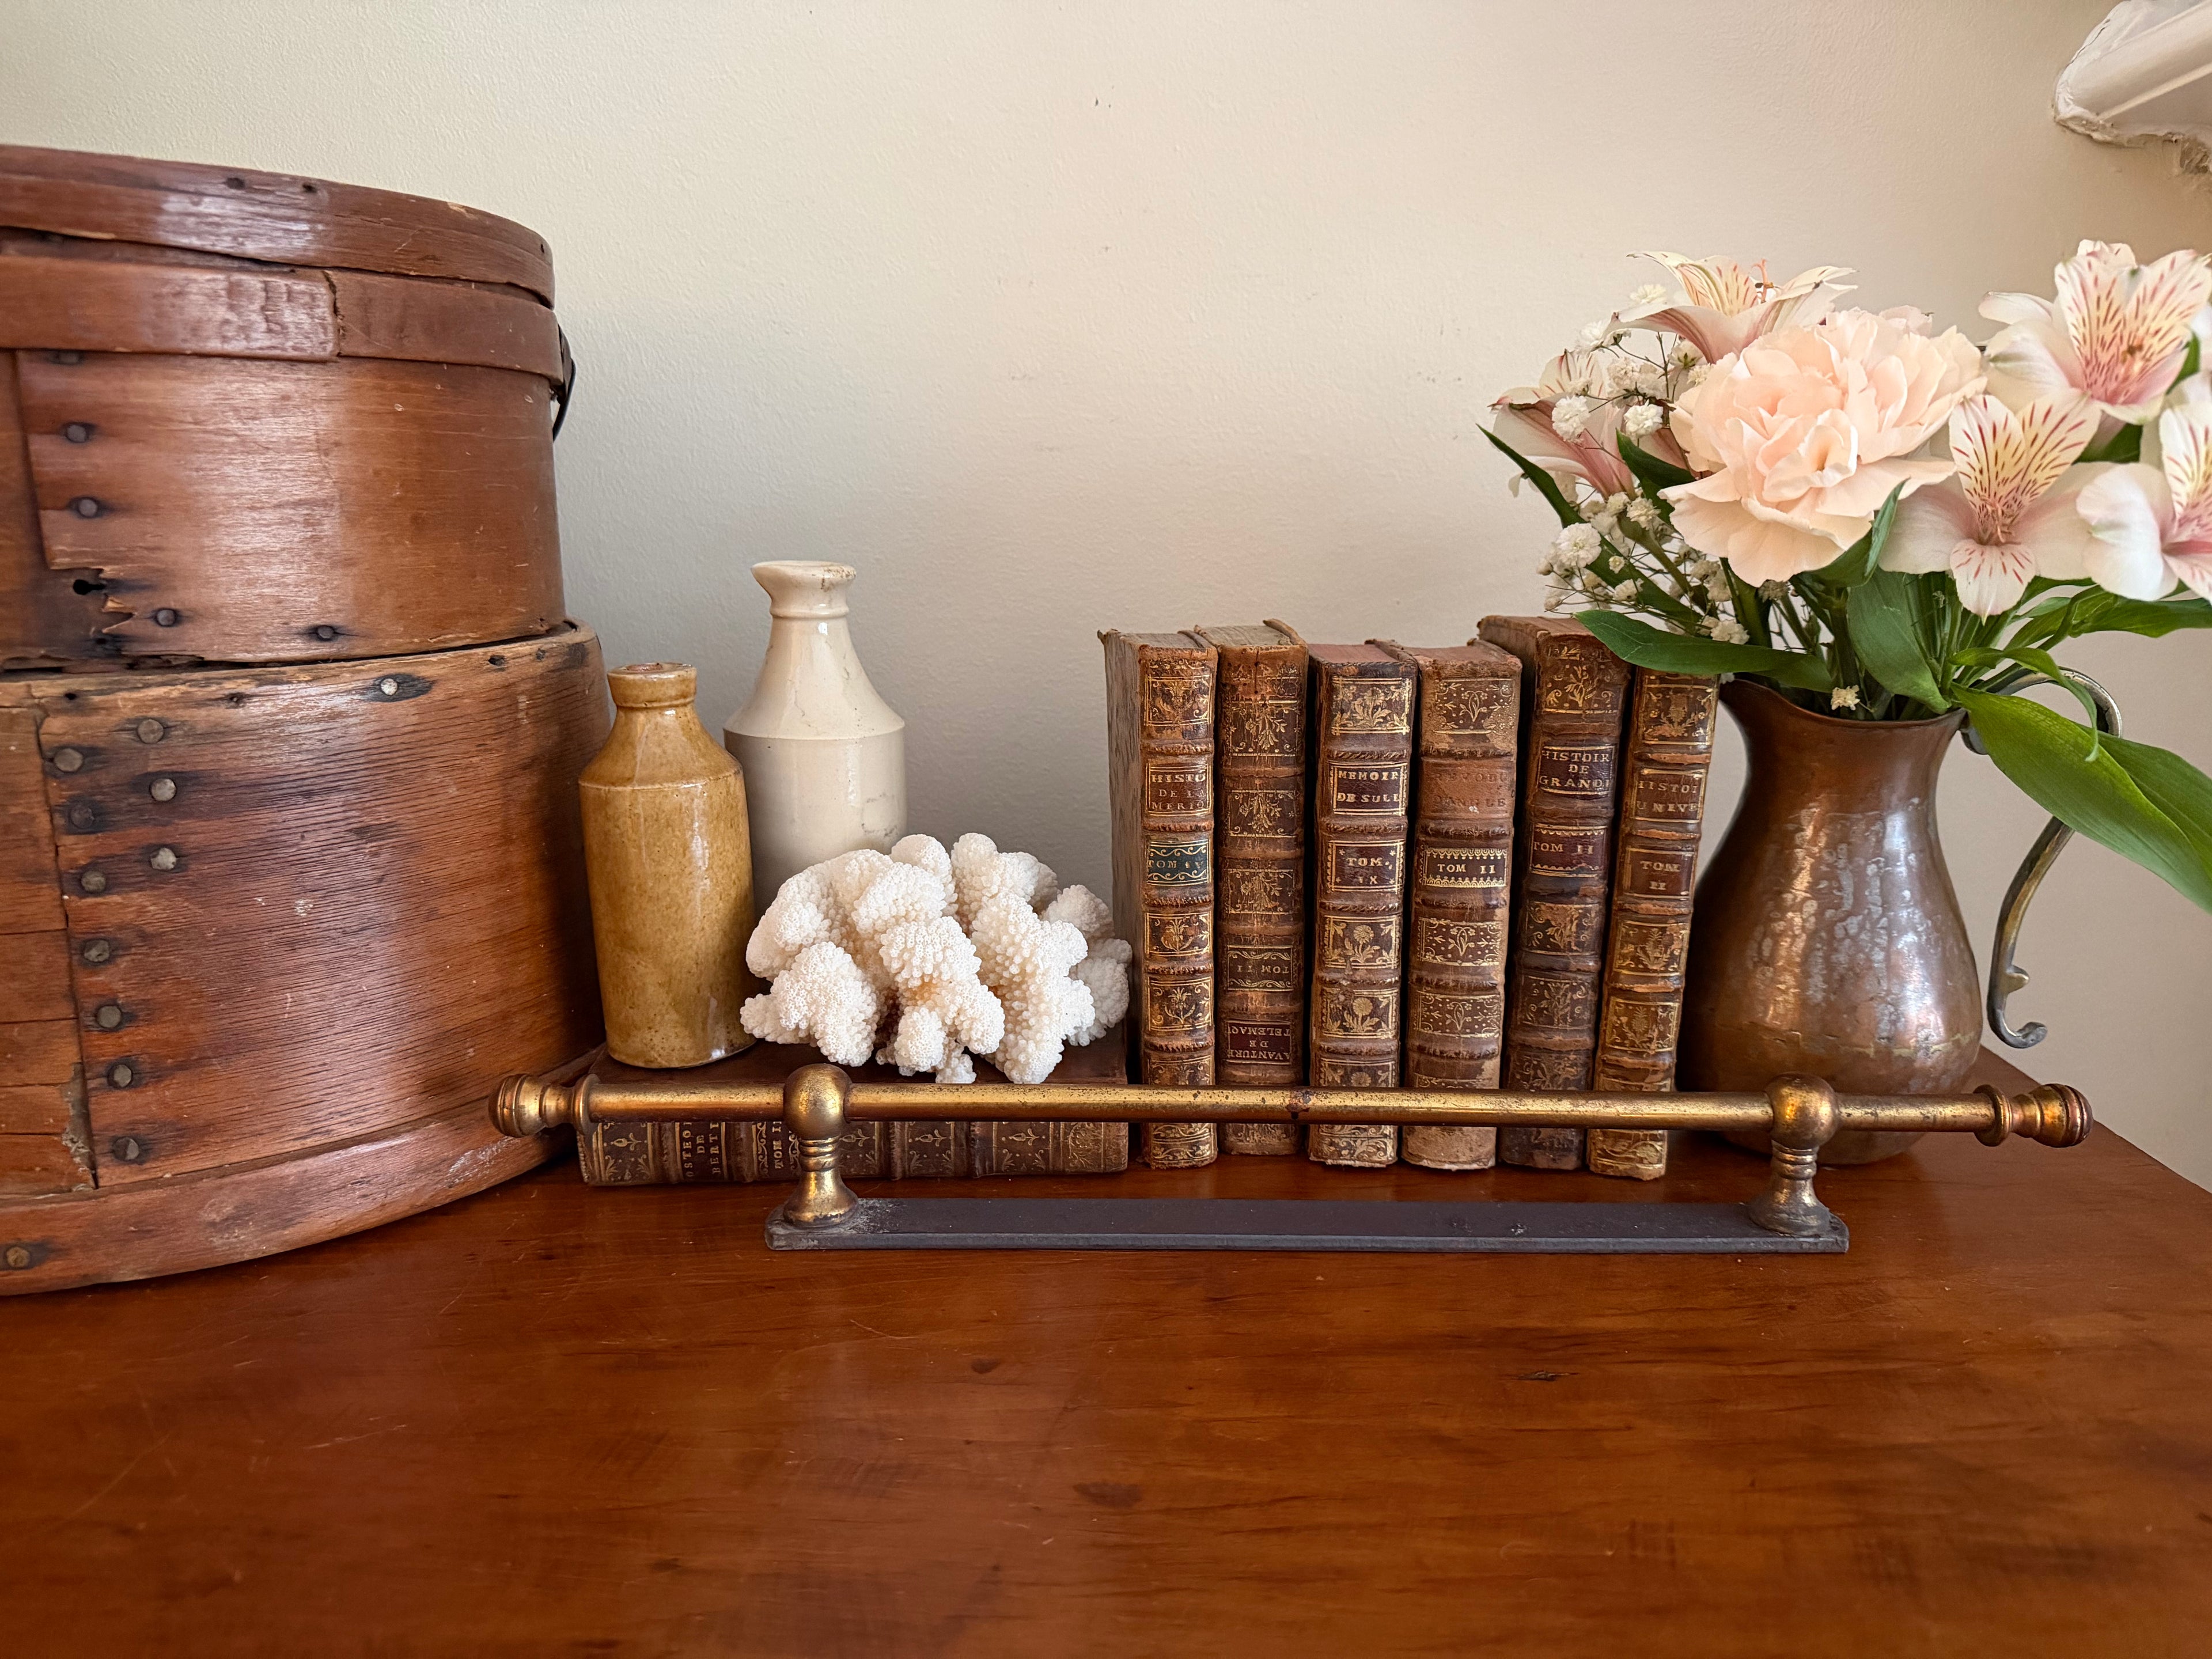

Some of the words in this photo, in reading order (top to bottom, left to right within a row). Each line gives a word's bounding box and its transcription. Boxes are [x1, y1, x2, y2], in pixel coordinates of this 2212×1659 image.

[1568, 764, 1590, 774] DE
[1152, 773, 1206, 783] HISTO
[1159, 789, 1178, 798] DE
[1336, 792, 1356, 802] DE
[1533, 842, 1564, 852] TOM
[1147, 859, 1177, 869] TOM
[1437, 863, 1467, 872] TOM
[1479, 865, 1496, 874] II
[1639, 860, 1682, 872] TOM
[1261, 965, 1289, 974] TOM
[1249, 1040, 1268, 1048] DE
[696, 1135, 706, 1154] DE
[773, 1140, 784, 1169] TOM
